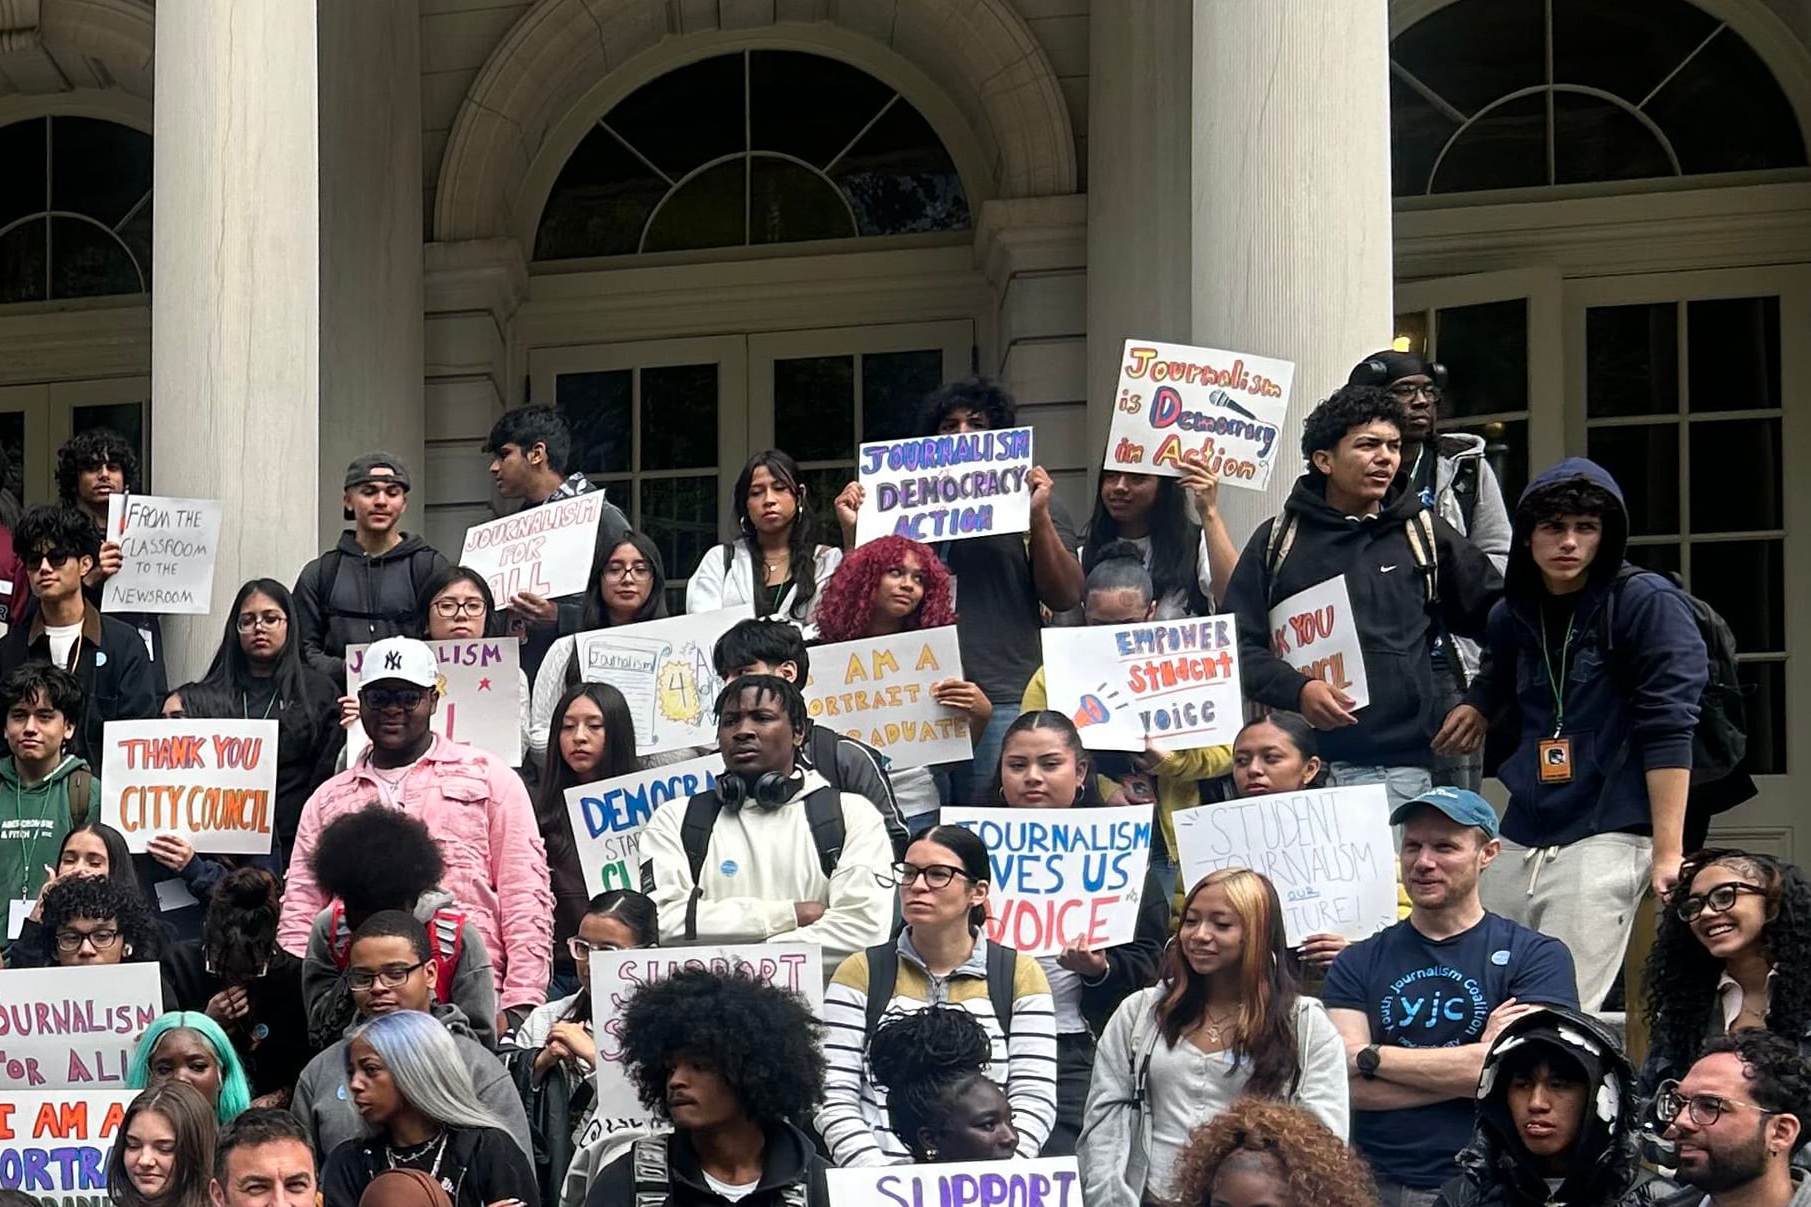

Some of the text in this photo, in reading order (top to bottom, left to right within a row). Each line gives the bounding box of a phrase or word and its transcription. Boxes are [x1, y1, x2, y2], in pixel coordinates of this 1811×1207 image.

[1125, 347, 1283, 398] Journalism
[1118, 386, 1277, 459] is Democracy
[861, 429, 1031, 475] JOURNALISM
[1115, 433, 1256, 479] in Action
[876, 464, 1028, 513] DEMOCRACY
[126, 503, 203, 529] FROM THE
[465, 496, 600, 553] JOURNALISM
[892, 503, 994, 541] ACTION
[120, 537, 208, 558] CLASSROOM
[498, 535, 547, 568] FOR
[136, 562, 179, 575] TO THE
[487, 561, 551, 607] ALL
[111, 585, 194, 604] NEWSROOM
[1115, 620, 1231, 657] EMPOWER
[1288, 604, 1335, 648] YOU
[845, 642, 940, 685] AM A
[668, 672, 688, 708] 4
[808, 683, 921, 716] ORTRAIT
[117, 734, 263, 770] THANK YOU
[120, 785, 271, 834] CITY COUNCIL
[1210, 790, 1348, 856] STUDENT
[991, 852, 1132, 894] VES US
[1286, 886, 1319, 900] OUR
[985, 895, 1121, 951] VOICE
[1284, 895, 1362, 936] TURE!
[1398, 991, 1465, 1029] yjc
[32, 1101, 89, 1140] AM
